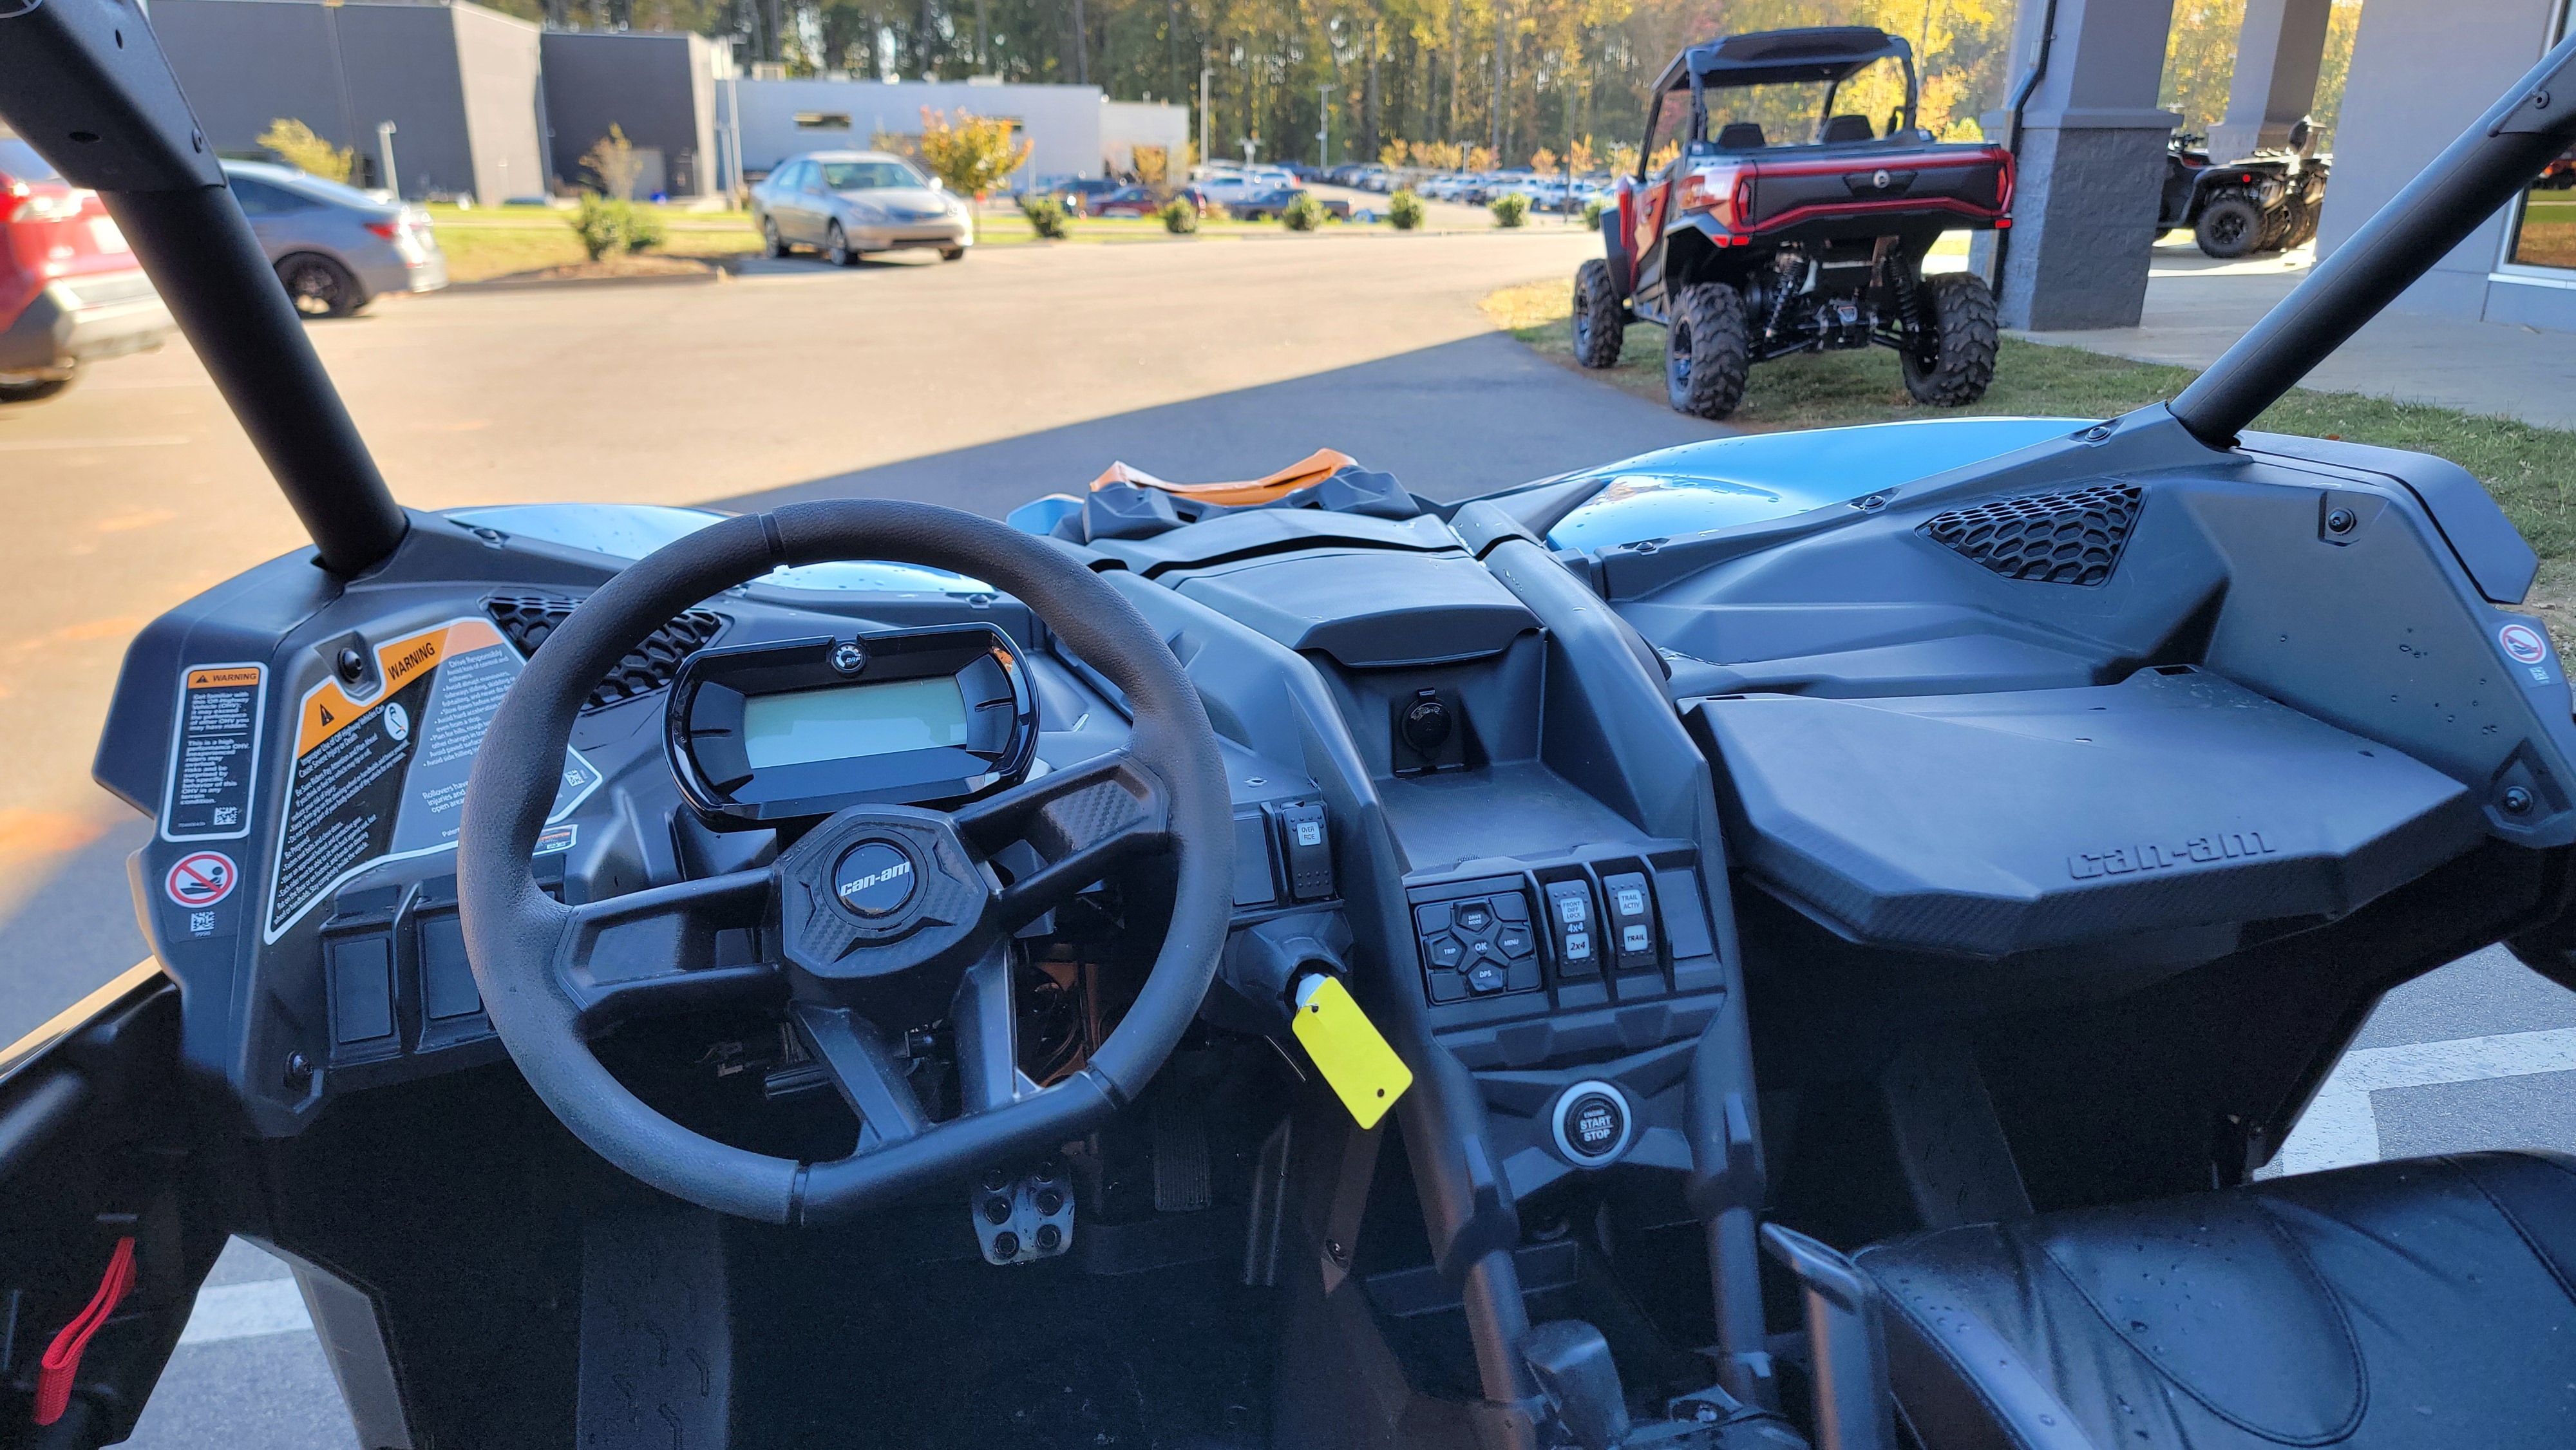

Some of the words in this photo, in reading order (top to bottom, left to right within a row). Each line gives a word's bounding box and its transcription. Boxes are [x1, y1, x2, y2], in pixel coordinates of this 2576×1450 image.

[388, 643, 435, 681] WARNING
[213, 673, 256, 682] WARNING
[422, 784, 453, 799] Rollovers
[2068, 832, 2277, 880] can-am
[840, 862, 910, 897] can-am
[1624, 901, 1640, 910] ACTIV
[1567, 922, 1584, 933] 4x4
[1627, 934, 1645, 943] TRAIL
[1475, 941, 1488, 952] OK
[1570, 941, 1586, 951] 2x4
[1580, 1115, 1612, 1130] START
[1584, 1128, 1611, 1142] STOP
